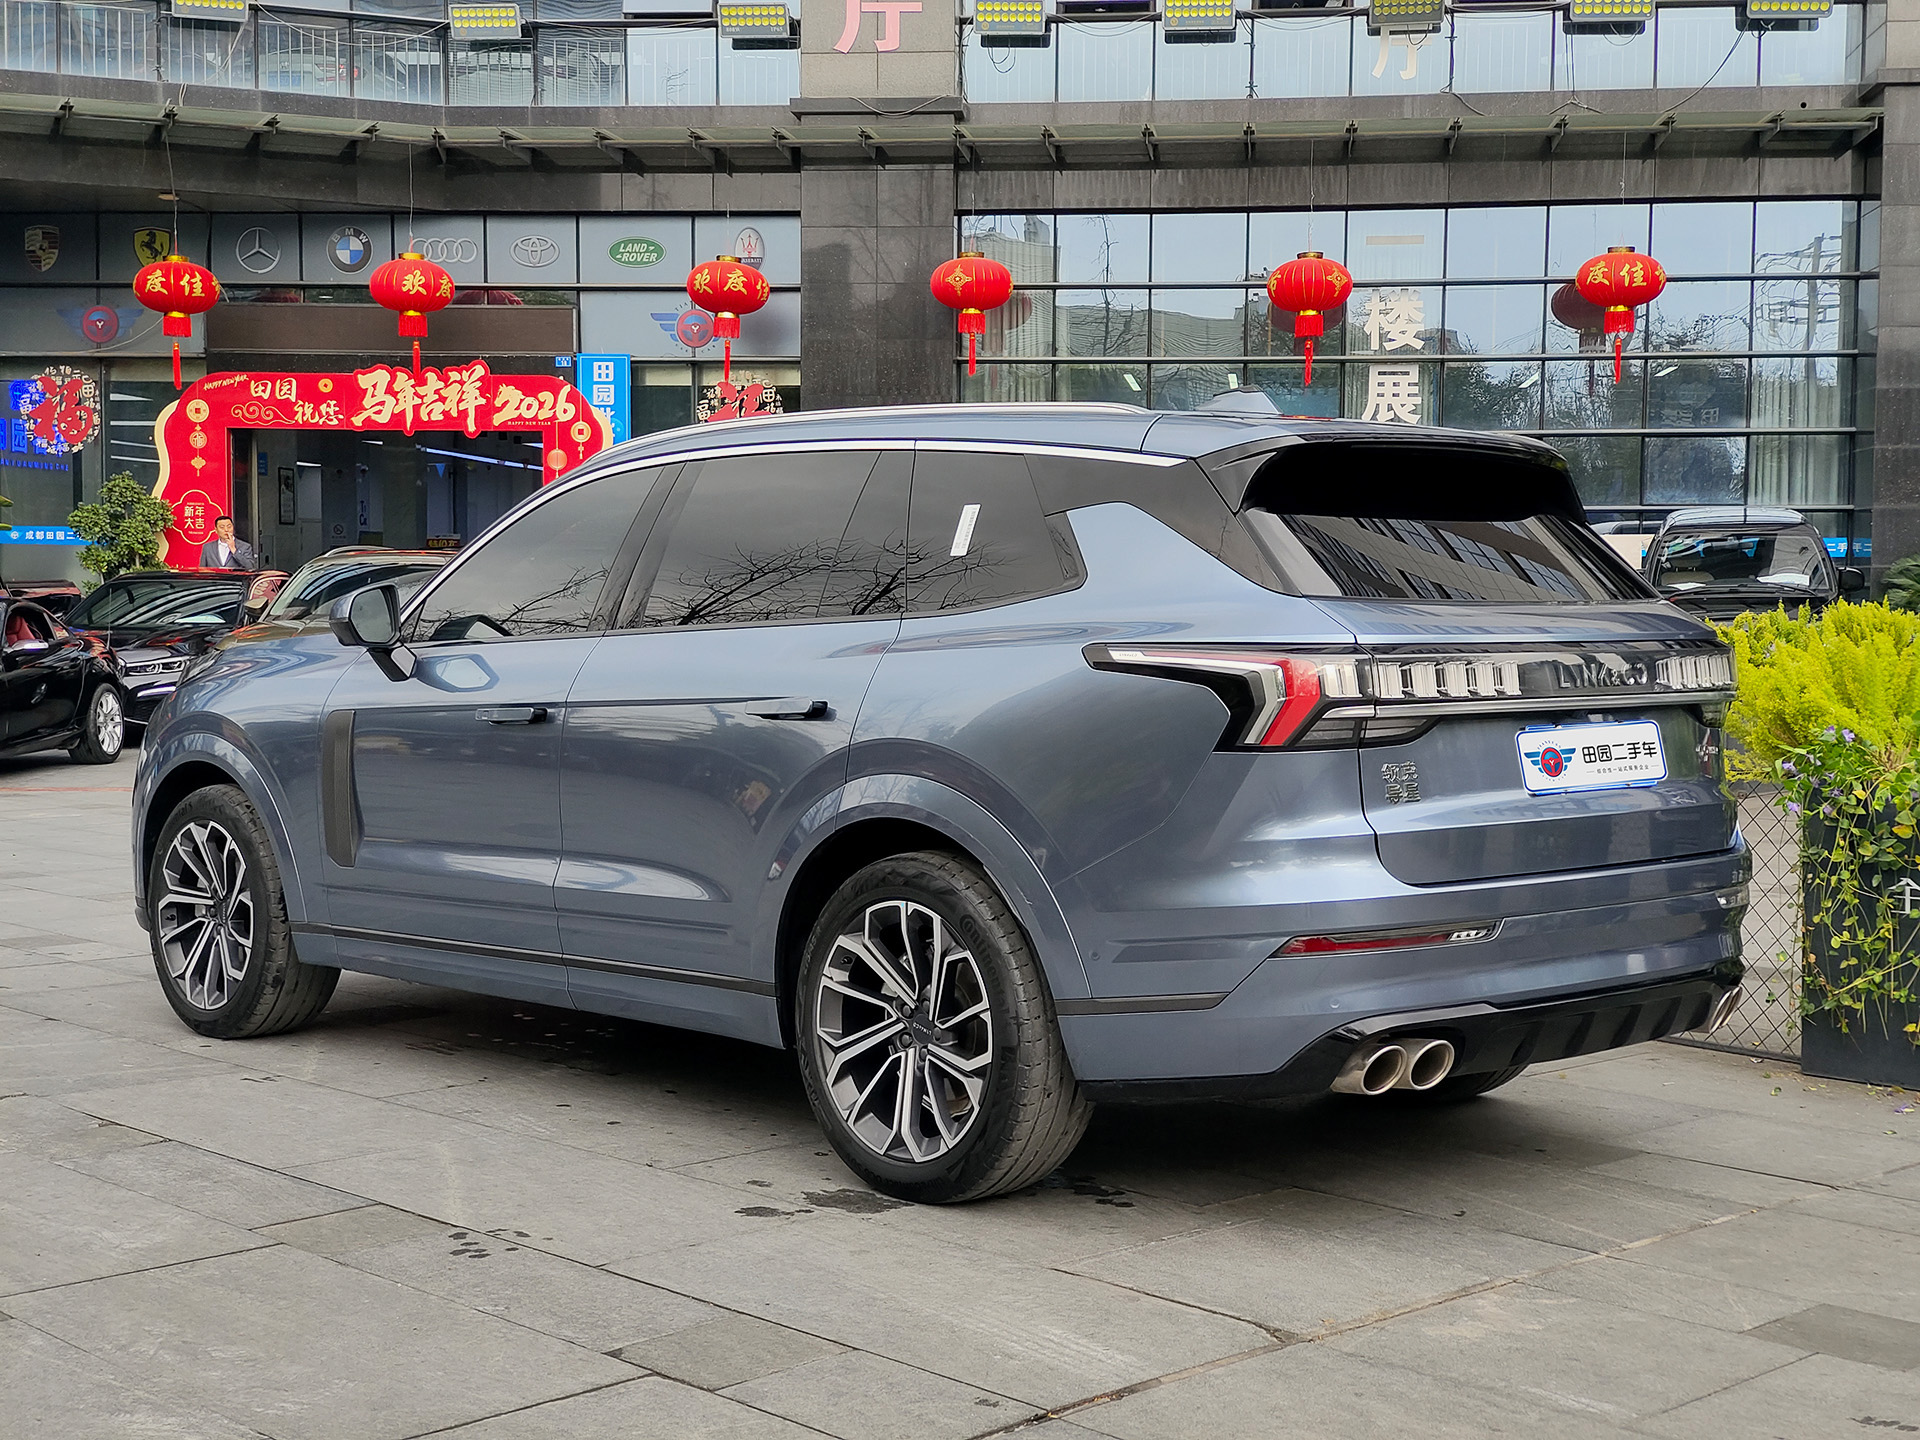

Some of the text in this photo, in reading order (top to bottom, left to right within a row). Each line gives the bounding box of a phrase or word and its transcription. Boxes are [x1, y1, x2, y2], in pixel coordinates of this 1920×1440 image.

[331, 228, 369, 243] BMW
[619, 243, 648, 253] LAND
[621, 252, 658, 262] ROVER
[250, 377, 297, 402] 田园
[350, 364, 487, 433] 马年吉祥
[293, 400, 344, 426] 祝您
[492, 383, 576, 427] 2026
[185, 506, 205, 517] 新年
[184, 518, 205, 529] 大吉
[1582, 741, 1657, 764] 田园二手车
